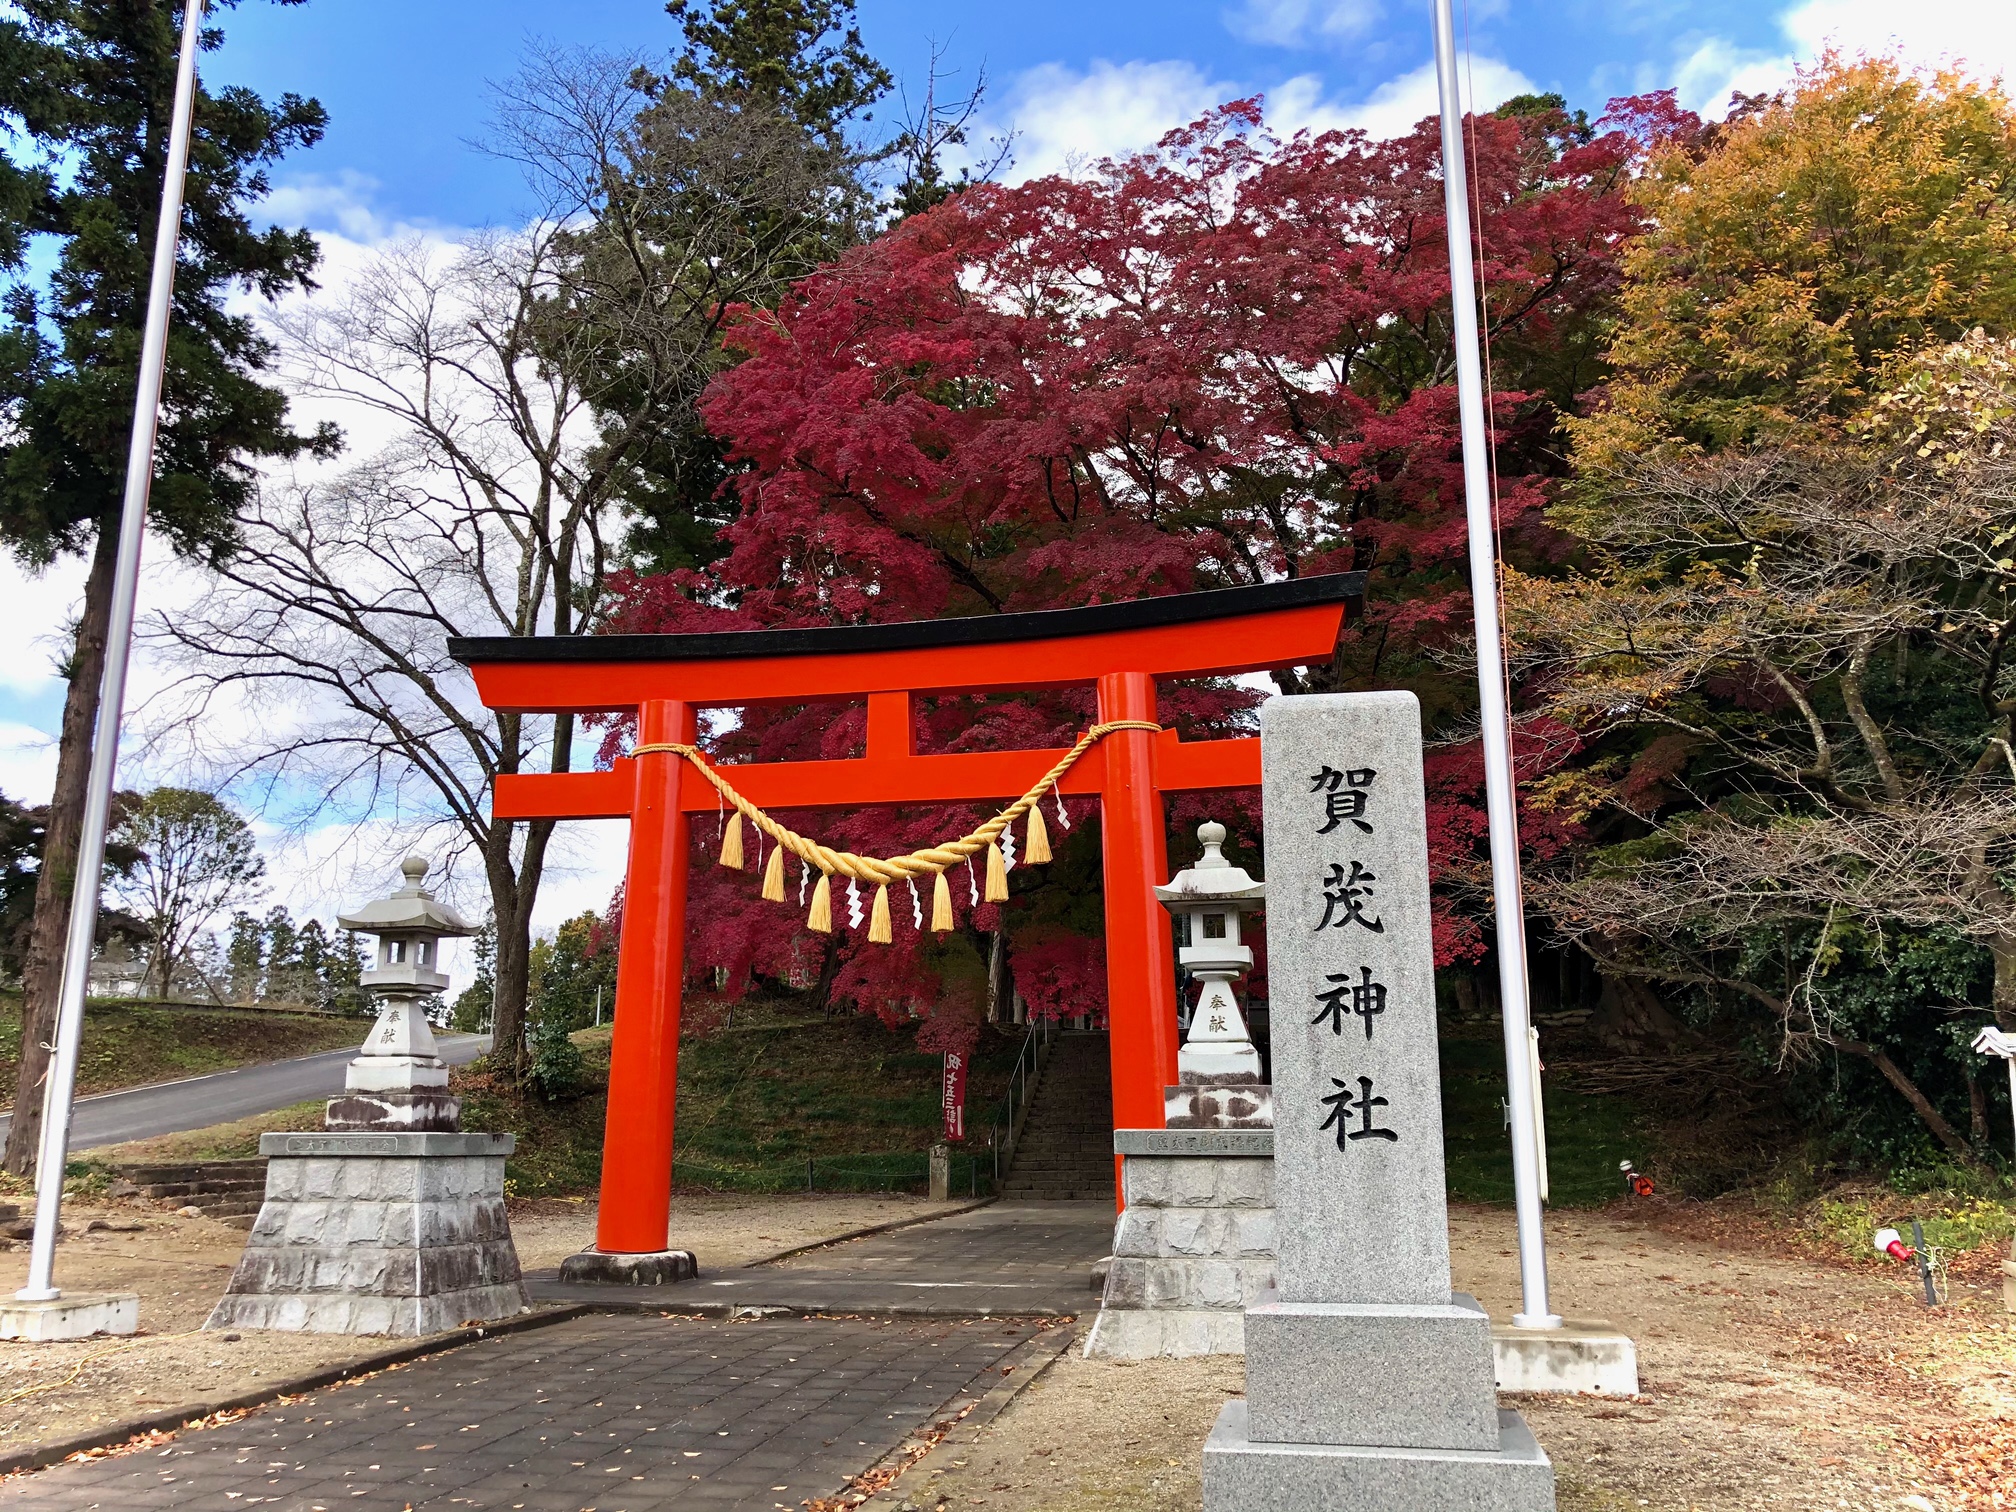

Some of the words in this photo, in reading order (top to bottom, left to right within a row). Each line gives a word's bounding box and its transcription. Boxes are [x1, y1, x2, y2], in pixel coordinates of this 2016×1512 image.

[1310, 766, 1398, 1152] 賀茂神社
[380, 1009, 401, 1044] 奉献
[1209, 994, 1227, 1033] 奉献
